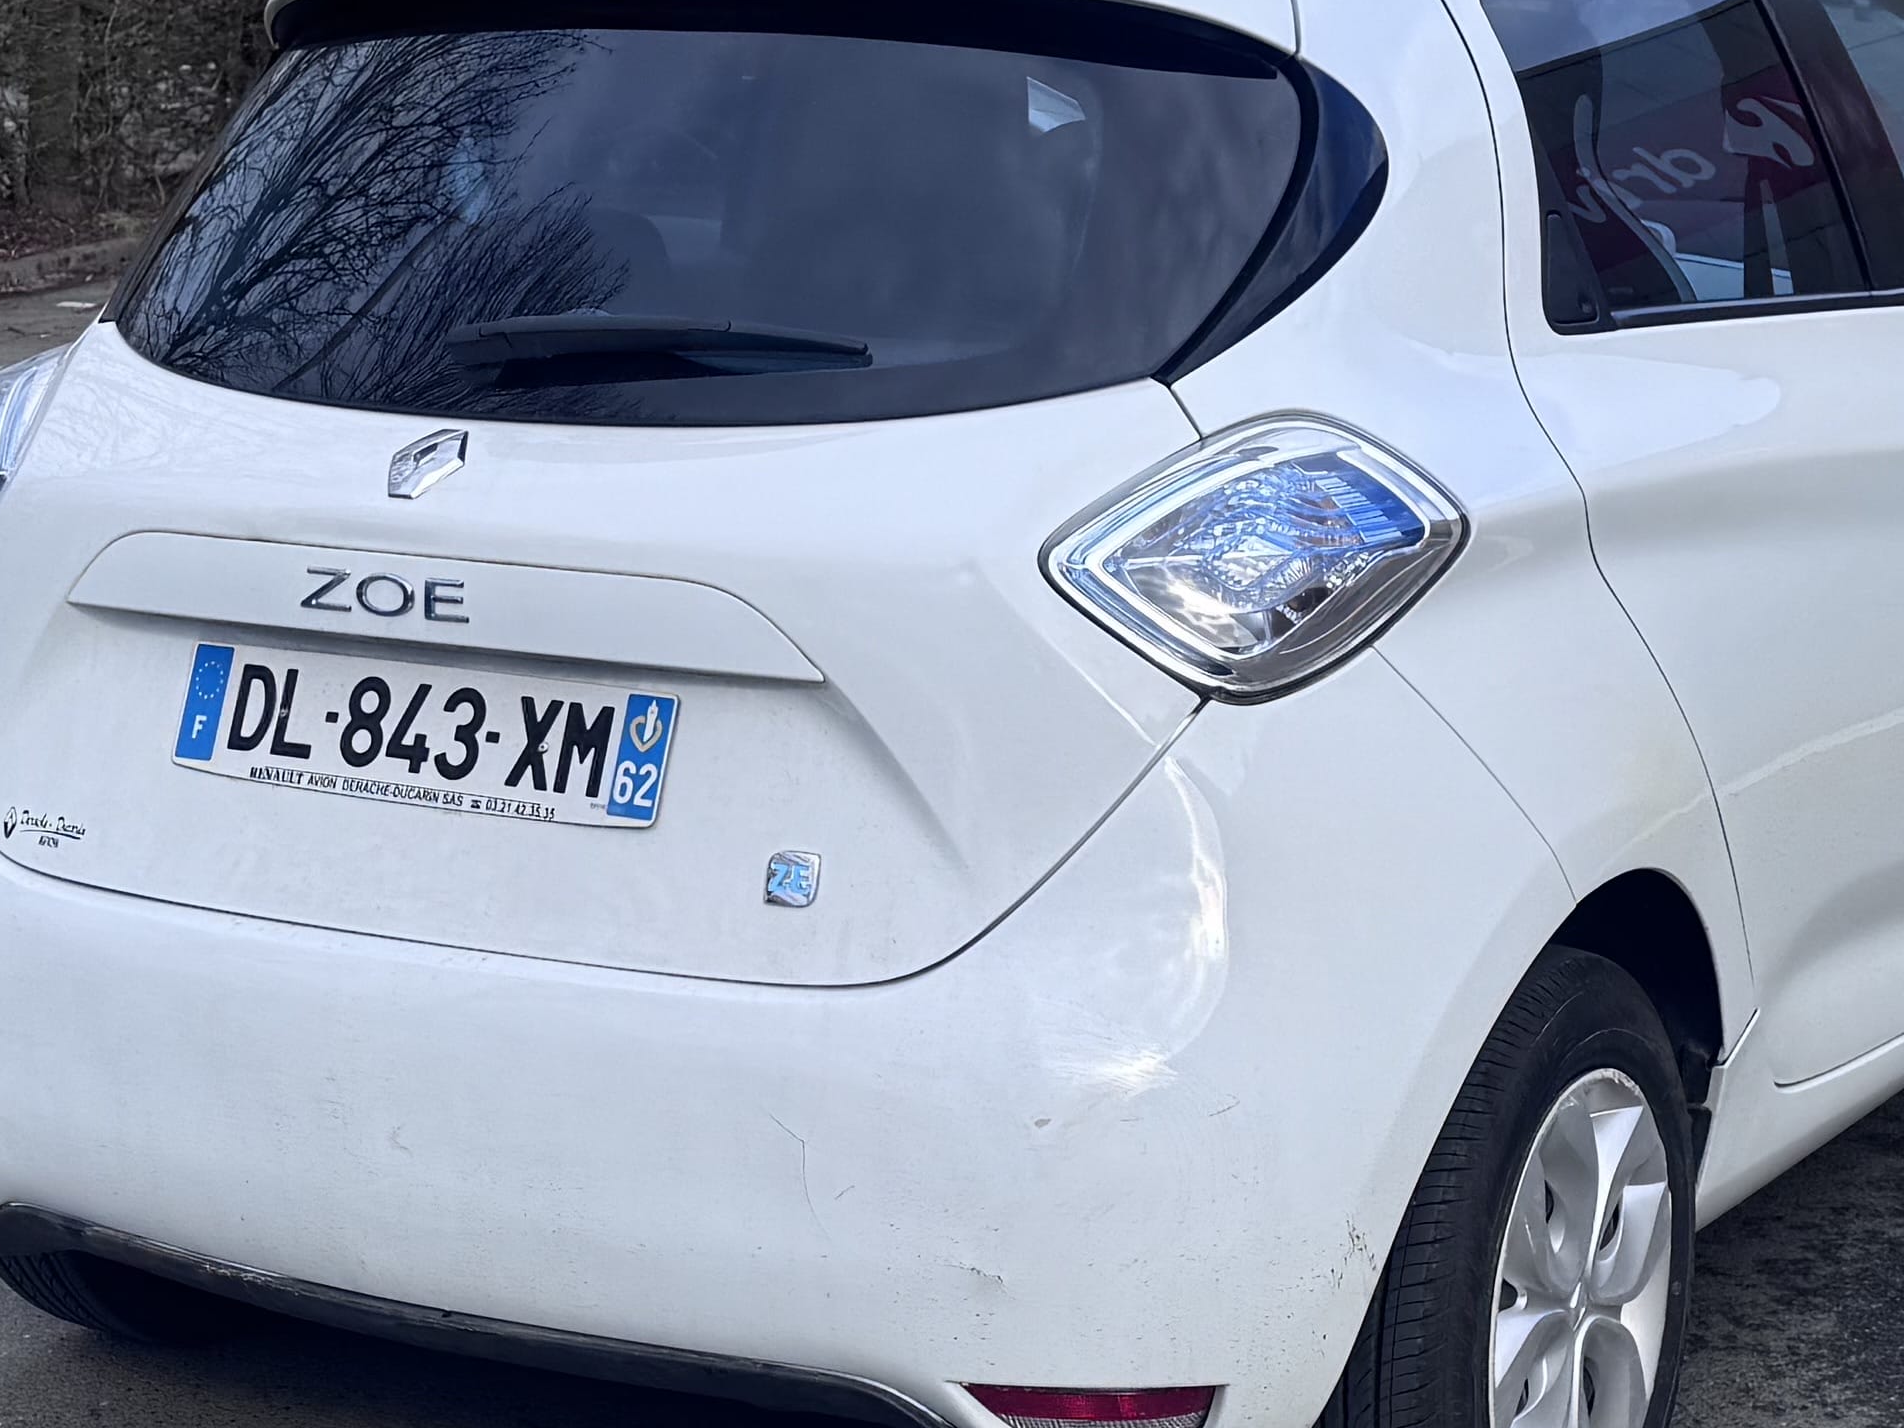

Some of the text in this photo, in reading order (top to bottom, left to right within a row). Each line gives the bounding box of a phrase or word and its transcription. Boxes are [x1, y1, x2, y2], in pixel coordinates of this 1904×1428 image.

[300, 566, 470, 624] ZOE
[191, 715, 208, 740] F
[226, 662, 616, 799] DL-843-XM
[307, 774, 338, 790] AVION
[442, 792, 464, 808] SAS
[612, 759, 661, 808] 62
